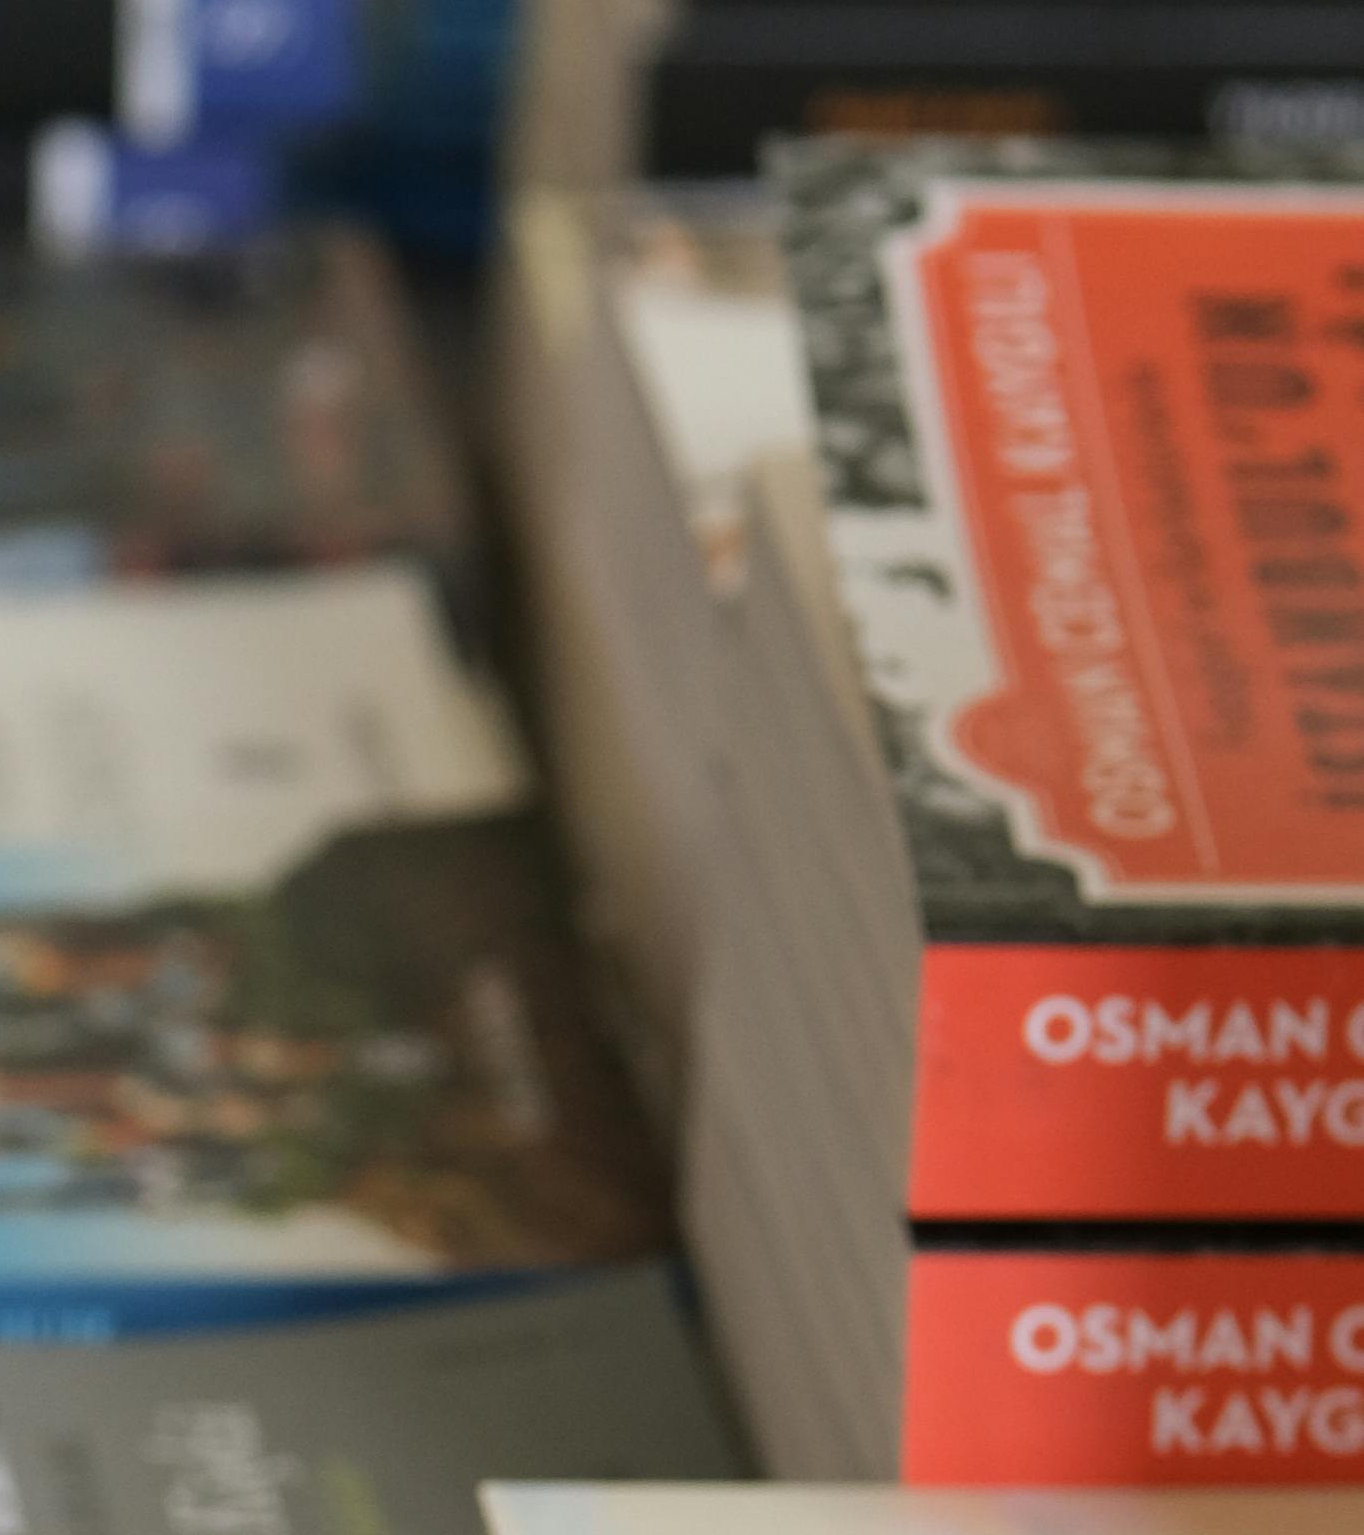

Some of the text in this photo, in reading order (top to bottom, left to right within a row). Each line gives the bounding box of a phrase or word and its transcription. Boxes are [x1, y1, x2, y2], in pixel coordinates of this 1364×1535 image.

[1023, 994, 1328, 1064] OSMAN
[1010, 1304, 1312, 1374] OSMAN
[1151, 1388, 1364, 1457] KAYG
